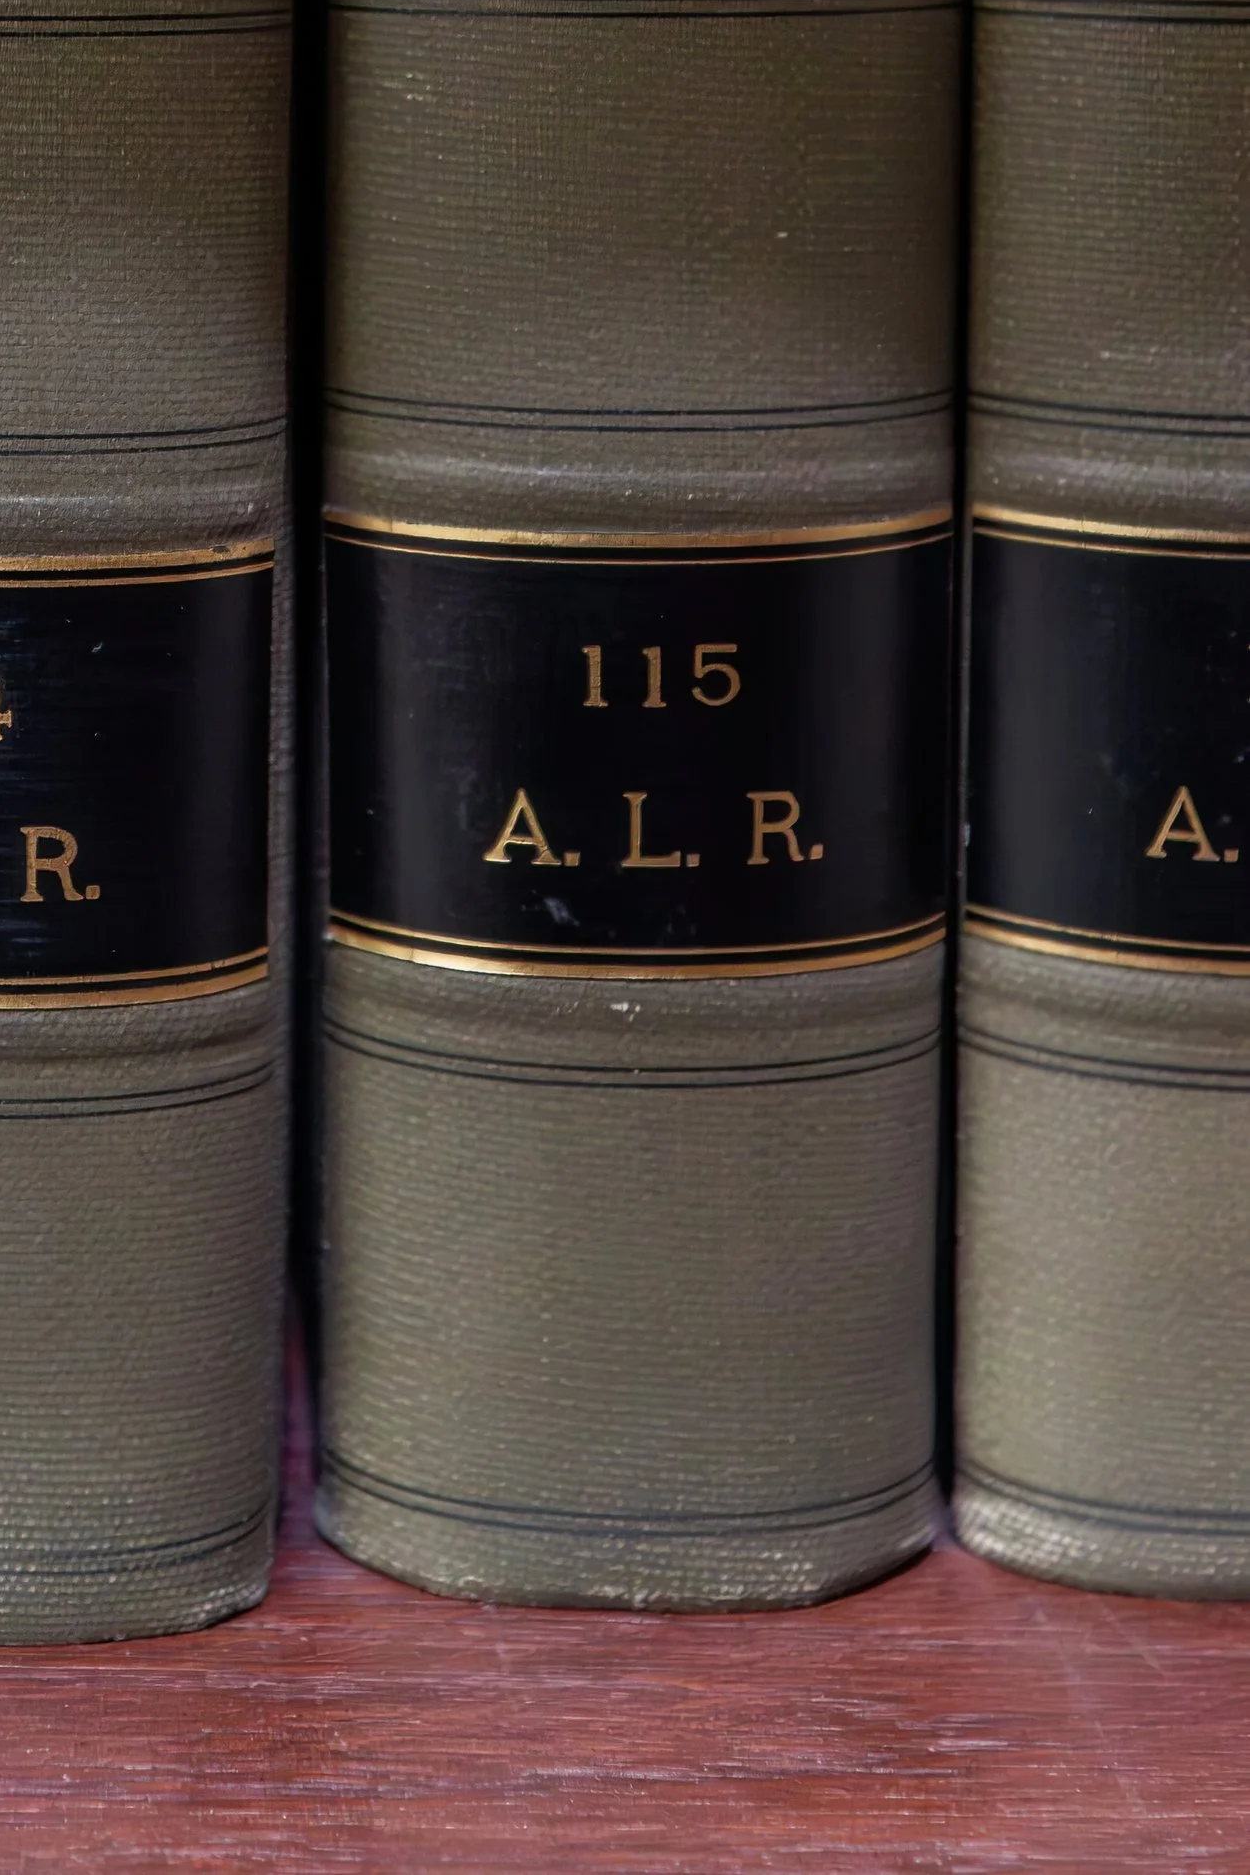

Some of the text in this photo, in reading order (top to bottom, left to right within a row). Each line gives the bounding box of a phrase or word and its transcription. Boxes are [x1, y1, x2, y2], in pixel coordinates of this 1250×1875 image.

[582, 644, 741, 708] 115
[483, 789, 824, 868] A. L. R.
[1144, 785, 1239, 863] A.
[20, 826, 101, 903] R.
